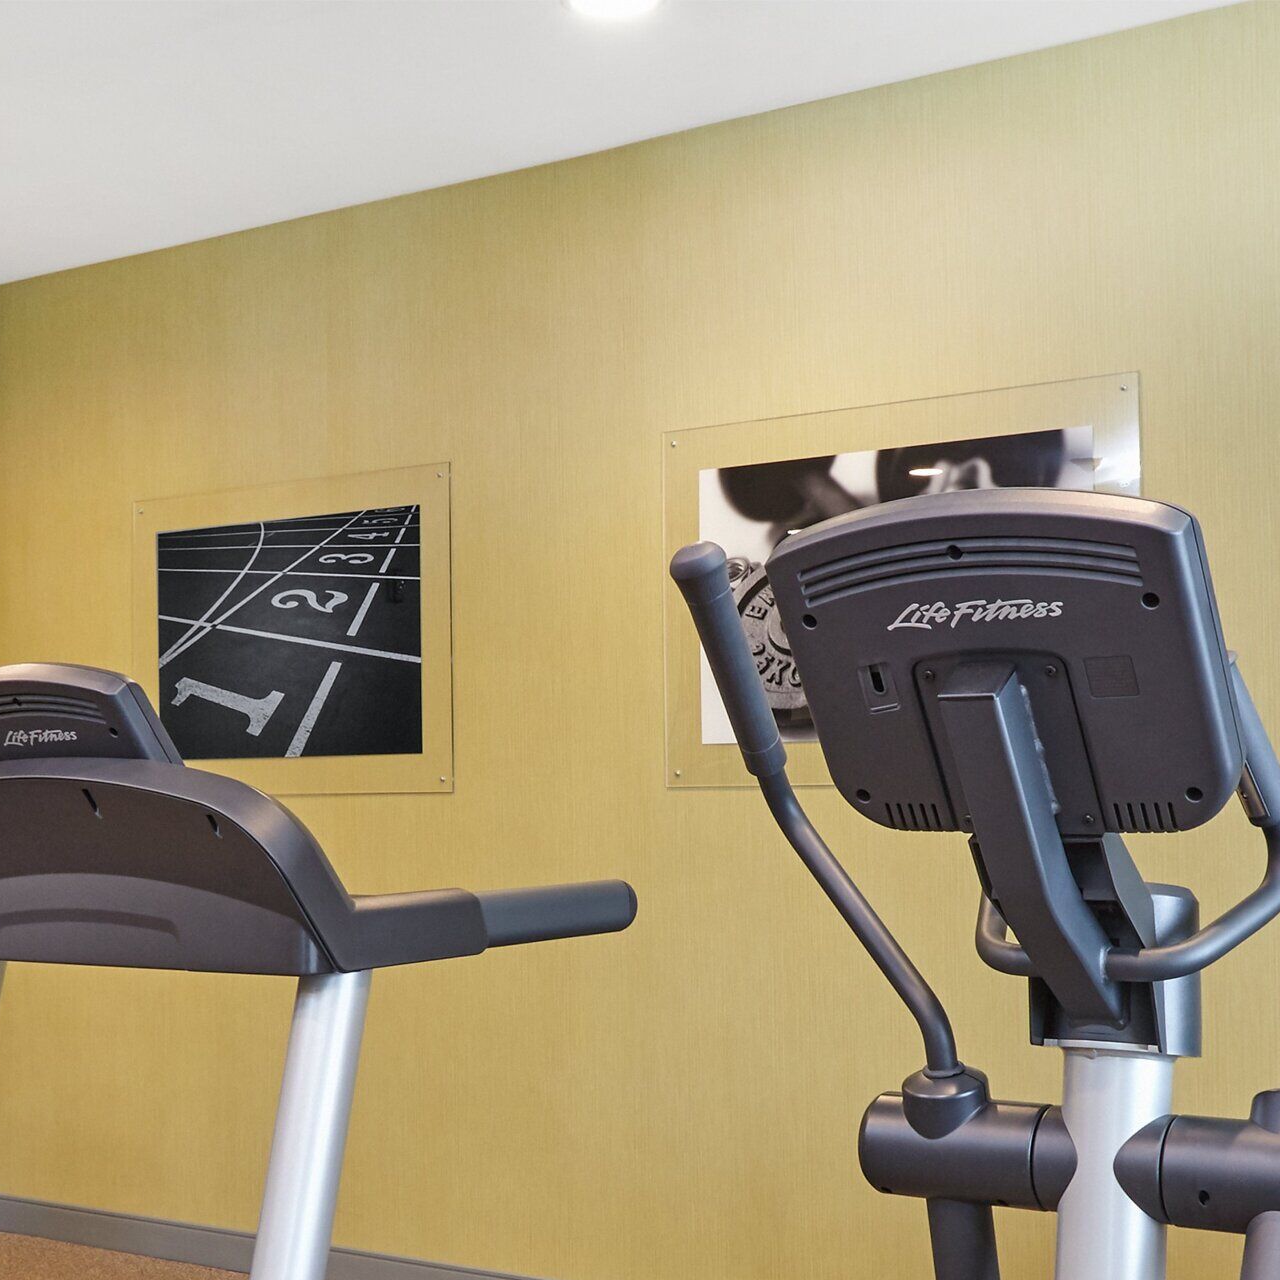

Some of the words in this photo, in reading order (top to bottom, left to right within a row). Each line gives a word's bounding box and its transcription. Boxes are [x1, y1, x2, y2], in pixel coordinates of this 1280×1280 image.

[347, 532, 390, 540] 4
[319, 553, 375, 565] 3
[271, 588, 348, 613] 2
[887, 601, 951, 631] Life
[950, 599, 1063, 629] Fitness
[171, 676, 285, 737] 1
[28, 729, 78, 746] Fitness
